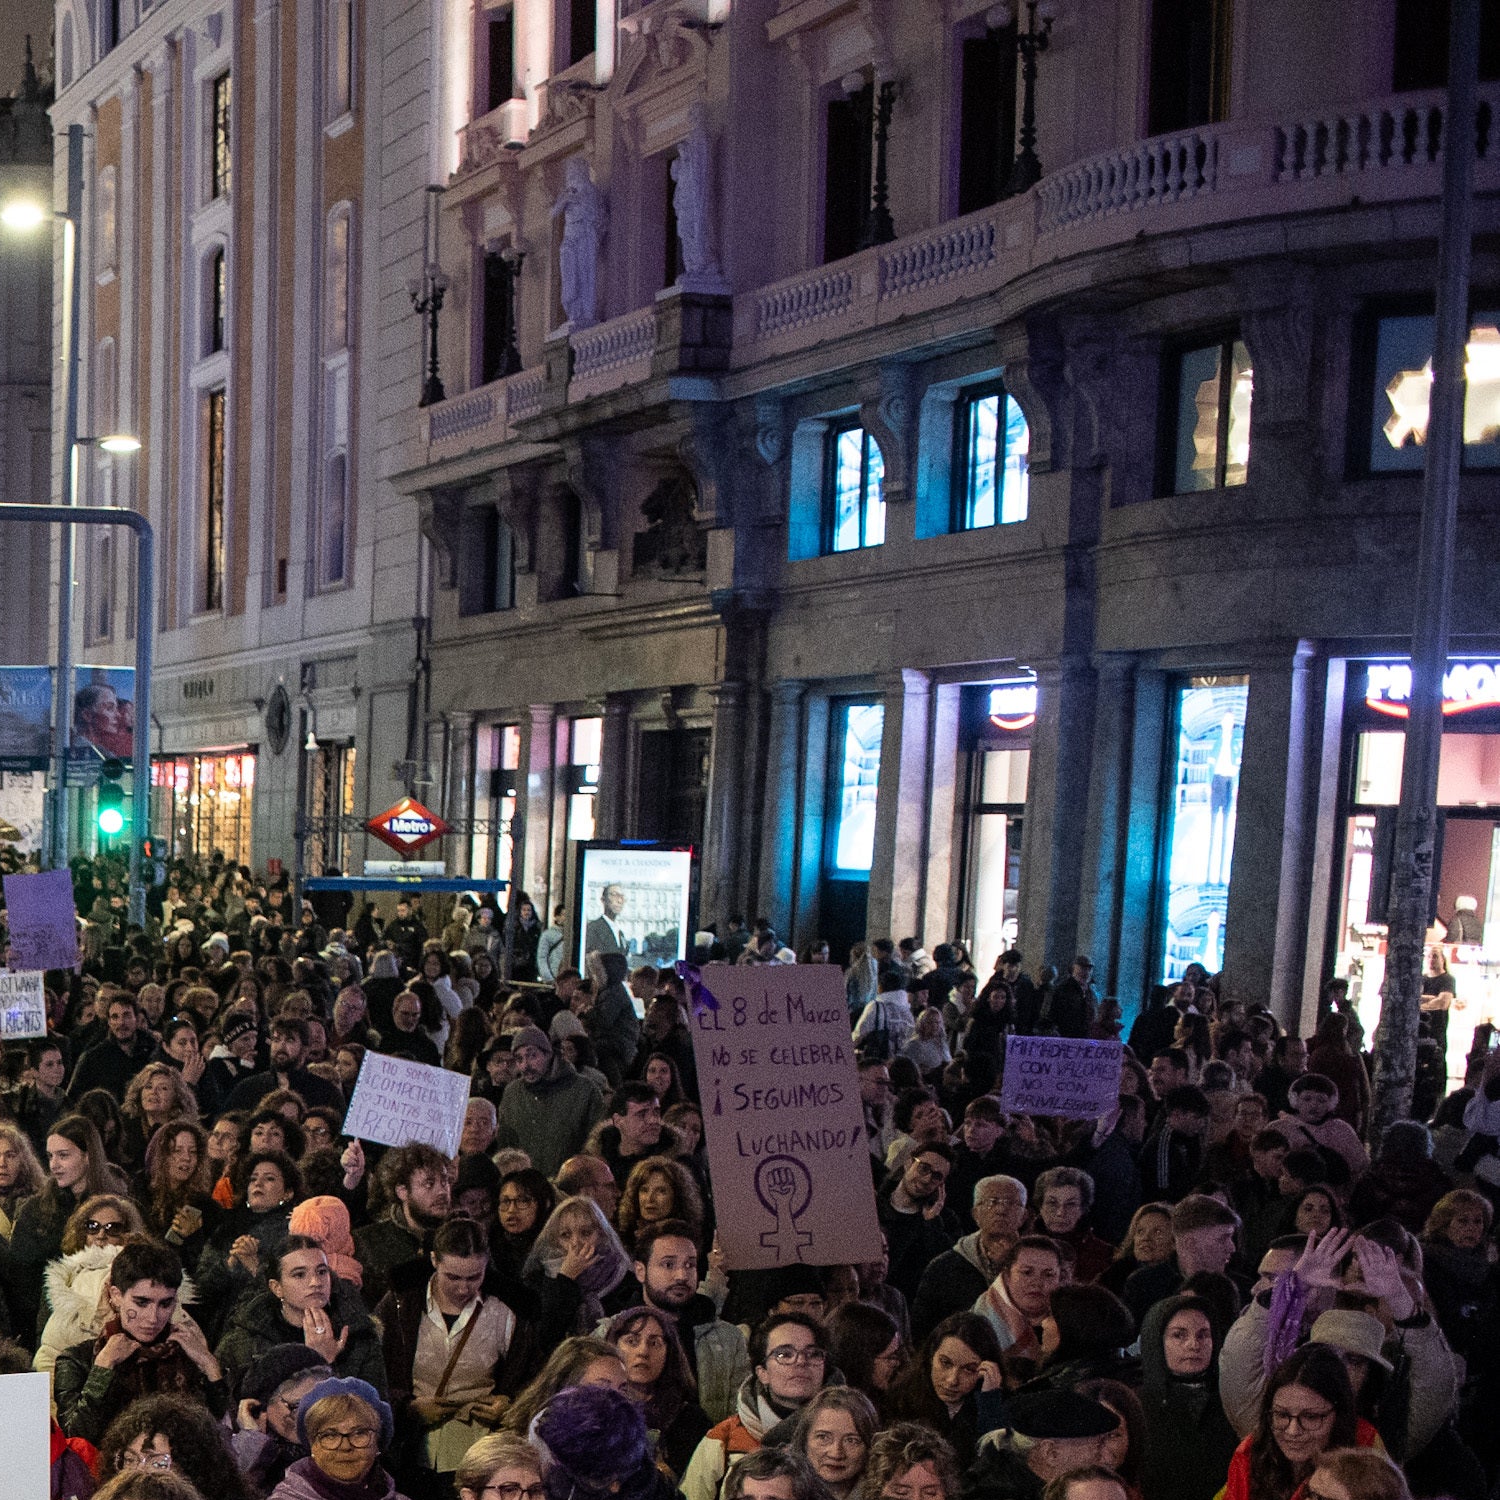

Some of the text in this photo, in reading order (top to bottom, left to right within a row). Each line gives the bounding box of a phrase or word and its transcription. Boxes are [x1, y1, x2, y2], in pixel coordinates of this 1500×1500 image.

[391, 819, 430, 833] Metro
[5, 1010, 43, 1034] RIGHTS
[698, 991, 841, 1031] EL 8 de Marzo
[738, 1049, 758, 1065] SE
[769, 1044, 848, 1067] CELEBRA
[382, 1060, 399, 1076] NO
[1020, 1060, 1117, 1080] CON VALORES
[734, 1082, 844, 1111] SEGUIMOS
[1021, 1079, 1089, 1094] NO CON
[736, 1125, 862, 1158] LUCHANDO!
